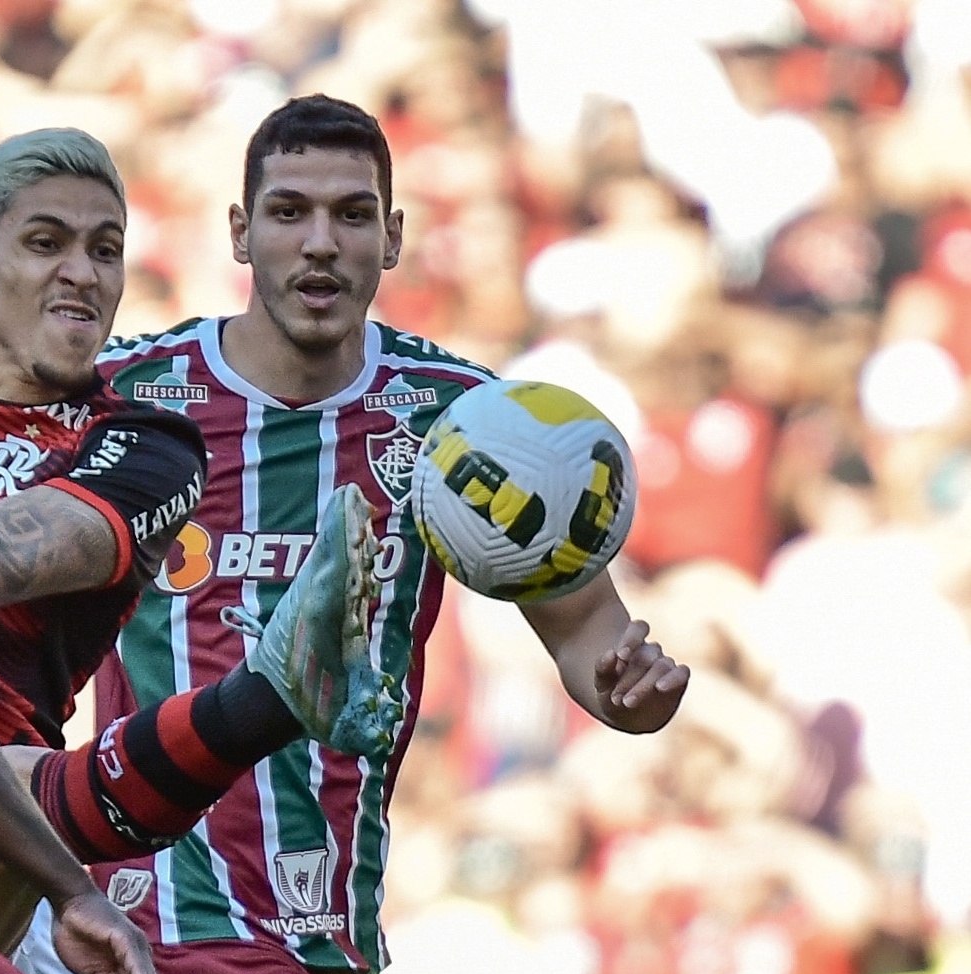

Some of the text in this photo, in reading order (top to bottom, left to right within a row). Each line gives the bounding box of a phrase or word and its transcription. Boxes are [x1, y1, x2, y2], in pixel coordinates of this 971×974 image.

[137, 386, 204, 399] FRESCATTO
[367, 390, 433, 407] FRESCATTO
[130, 471, 203, 544] HAVAN
[216, 532, 405, 580] BETO
